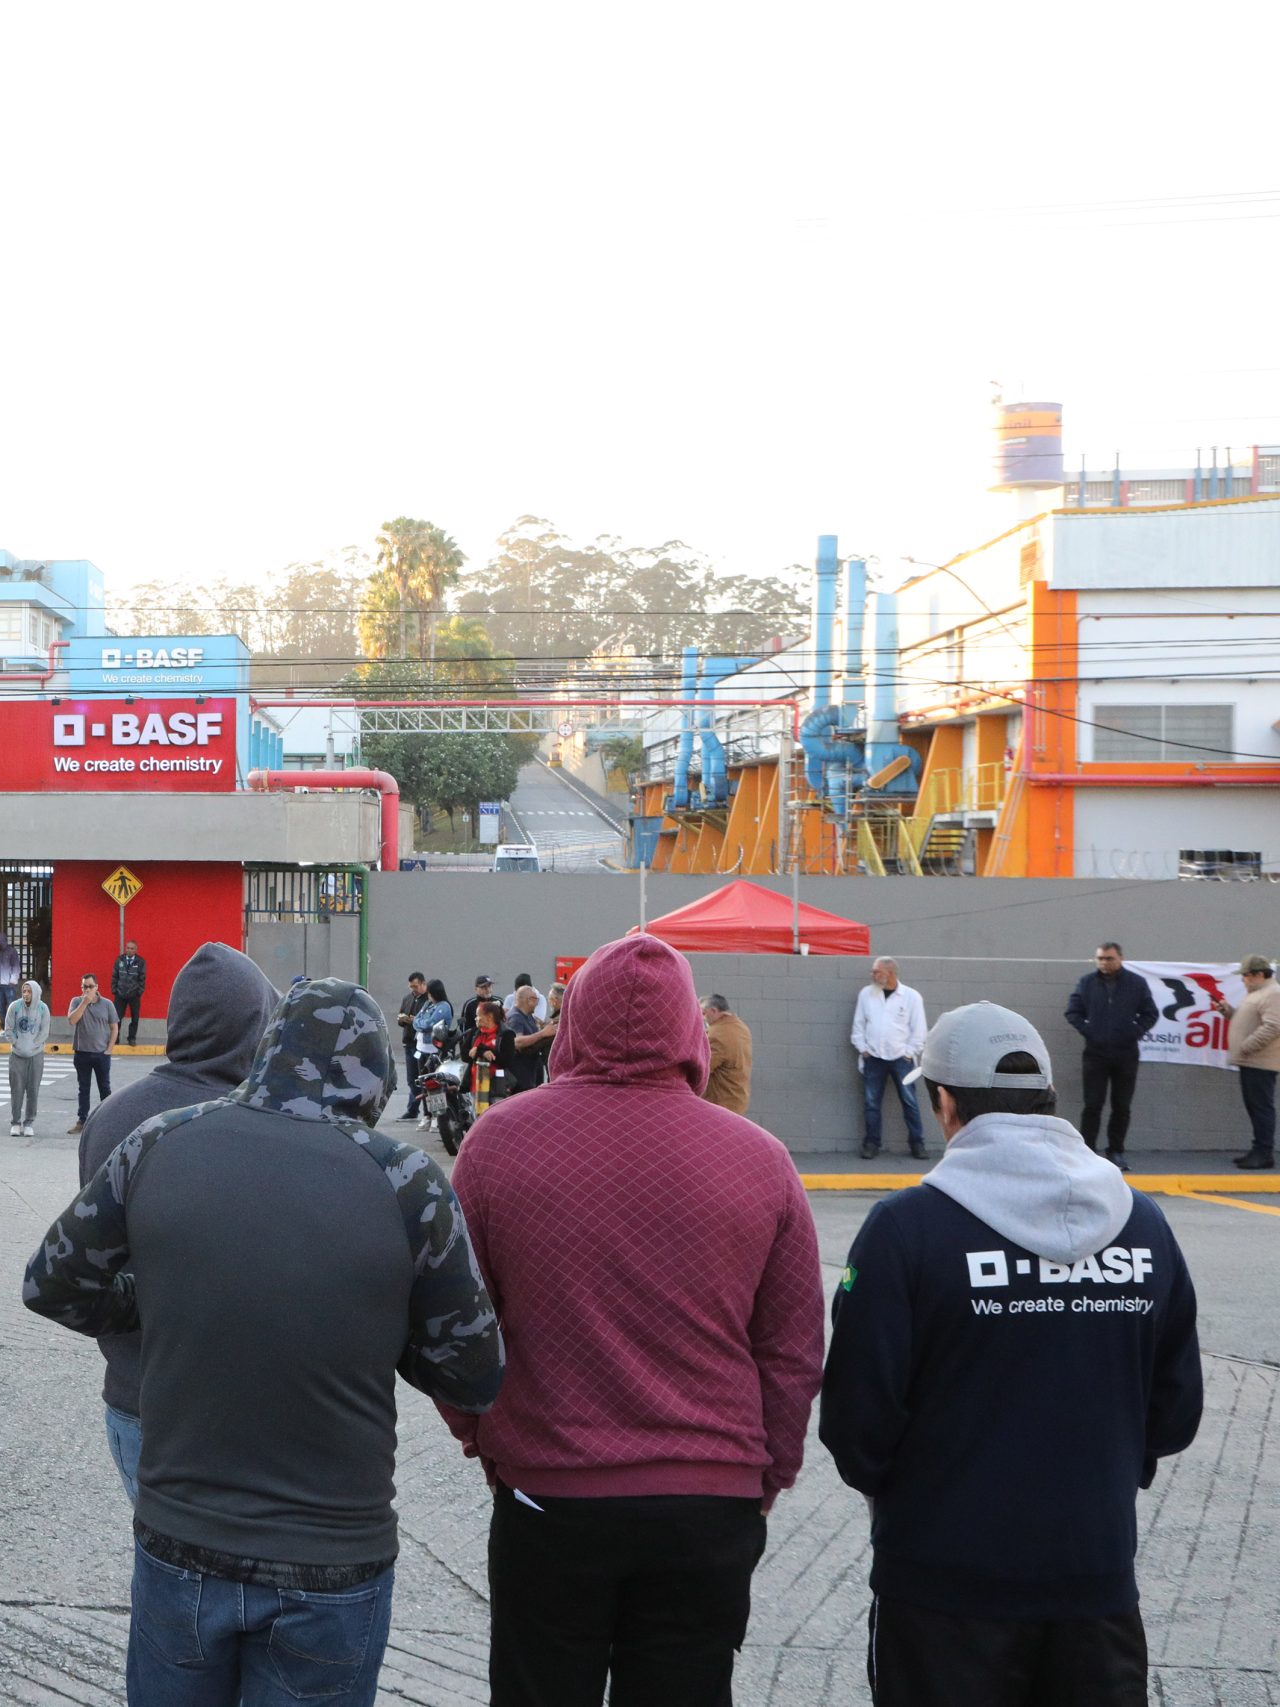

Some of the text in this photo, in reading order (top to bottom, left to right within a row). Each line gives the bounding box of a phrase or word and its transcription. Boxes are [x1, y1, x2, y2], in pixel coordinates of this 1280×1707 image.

[137, 648, 204, 668] BASF
[102, 673, 204, 685] We create chemistry
[112, 713, 222, 745] BASF
[54, 756, 222, 775] We create chemistry
[1140, 1016, 1231, 1051] dustri all
[1039, 1247, 1153, 1284] BASF
[971, 1296, 1154, 1315] We create chemistry
